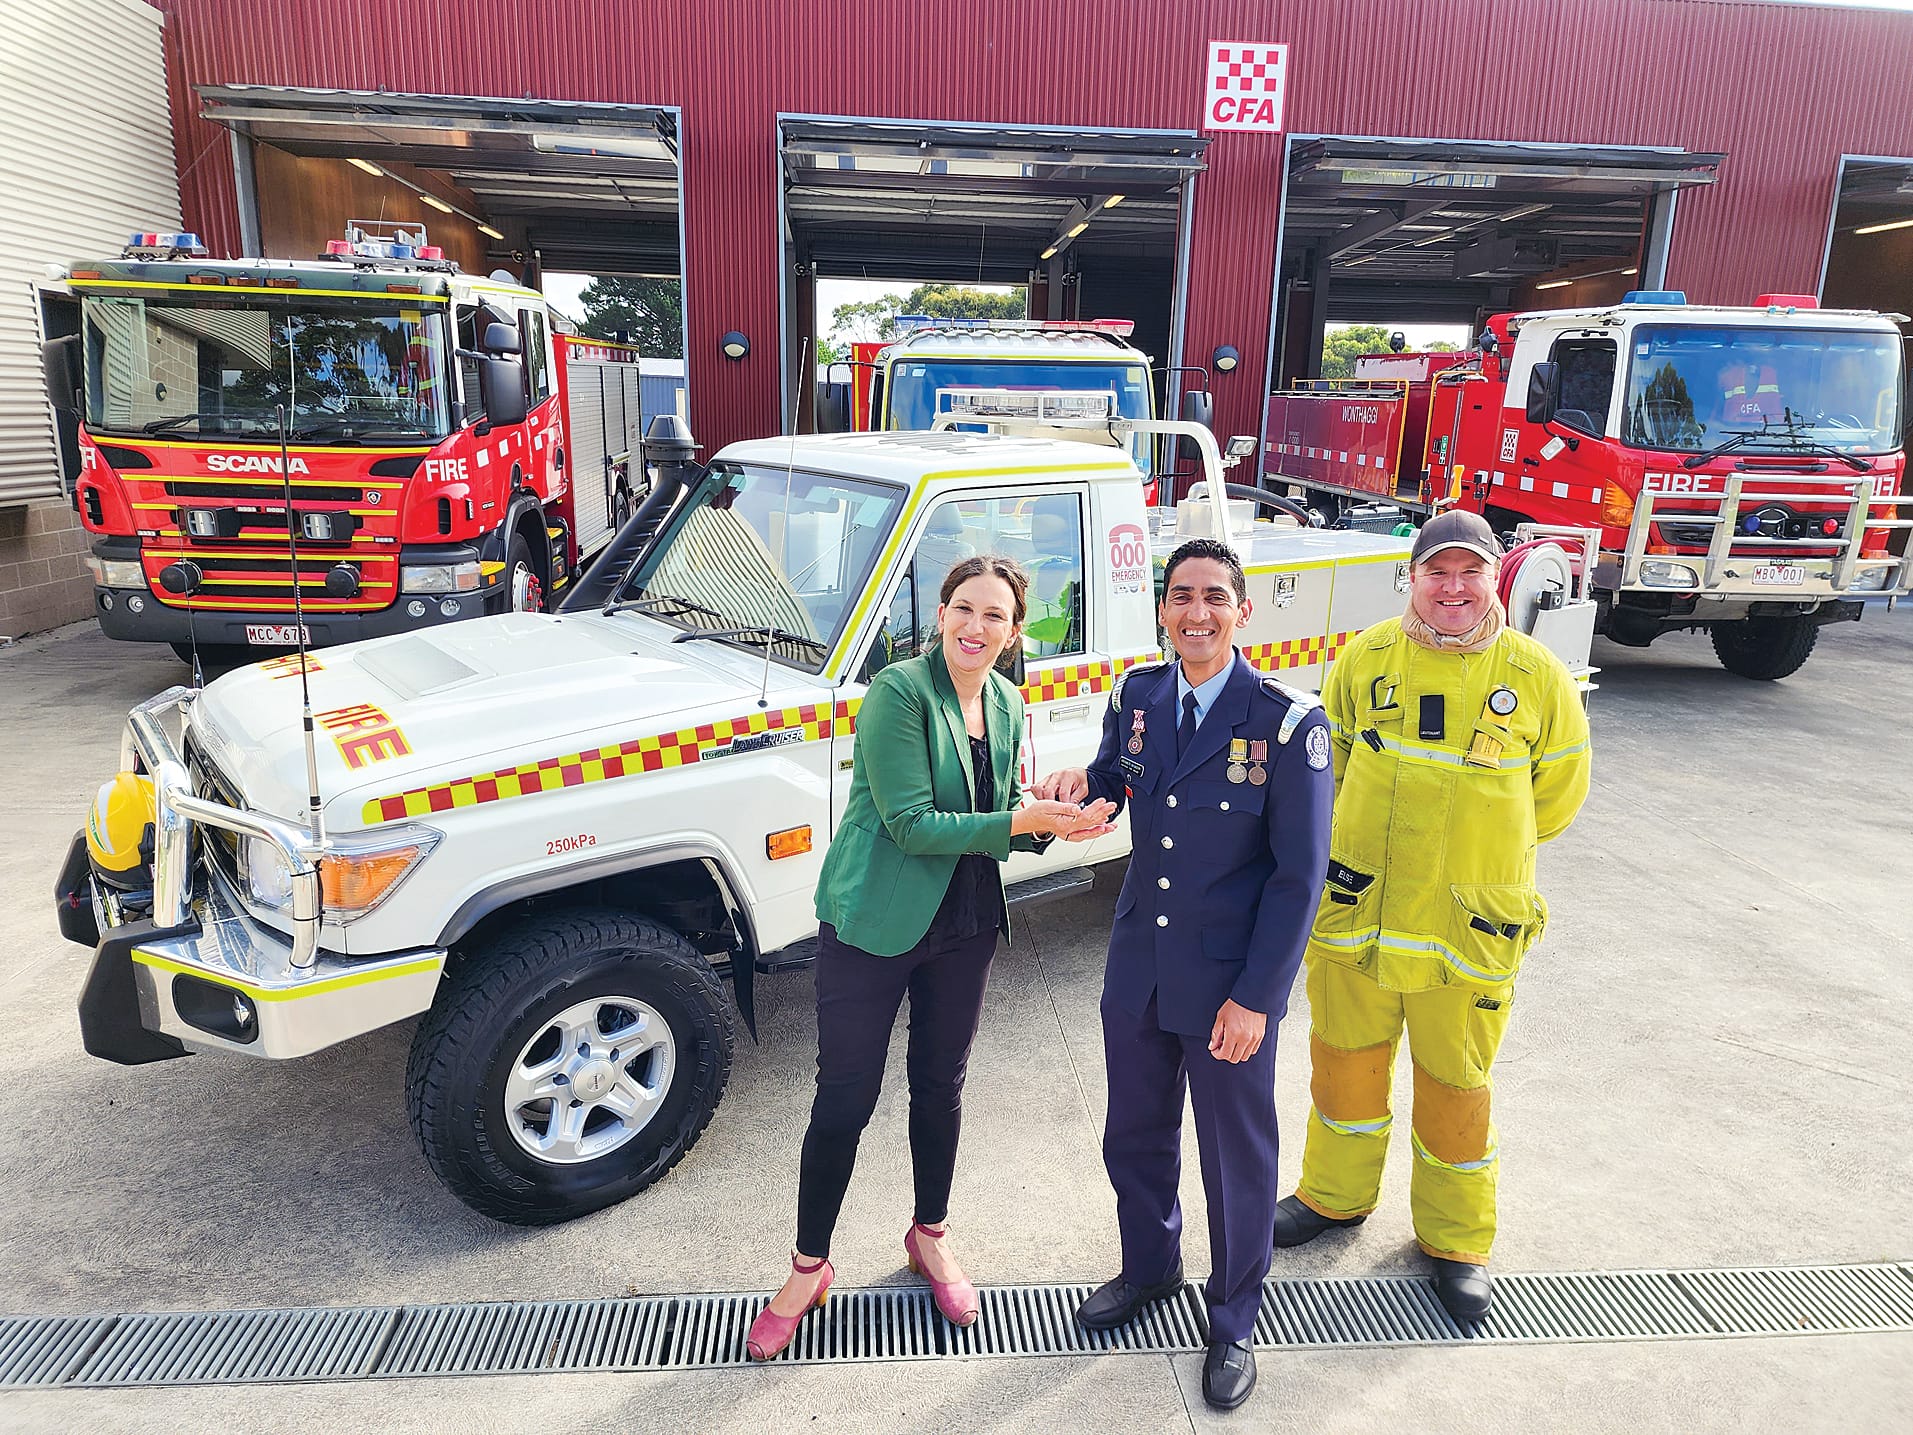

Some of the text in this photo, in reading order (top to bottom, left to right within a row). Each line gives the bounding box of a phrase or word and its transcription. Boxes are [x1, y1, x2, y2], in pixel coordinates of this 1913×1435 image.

[1212, 96, 1274, 124] CFA
[1342, 405, 1379, 424] WONTHAGGI
[1741, 403, 1761, 414] CFA
[1502, 448, 1514, 458] CFA
[425, 458, 469, 482] FIRE
[1643, 472, 1713, 493] FIRE
[1110, 542, 1146, 568] 000
[1111, 569, 1147, 582] EMERGENCY
[1755, 568, 1802, 581] MBQ 001
[248, 628, 273, 641] MCC
[313, 702, 415, 771] FIRE
[546, 833, 597, 856] 250kPa
[1338, 869, 1354, 885] ELSE
